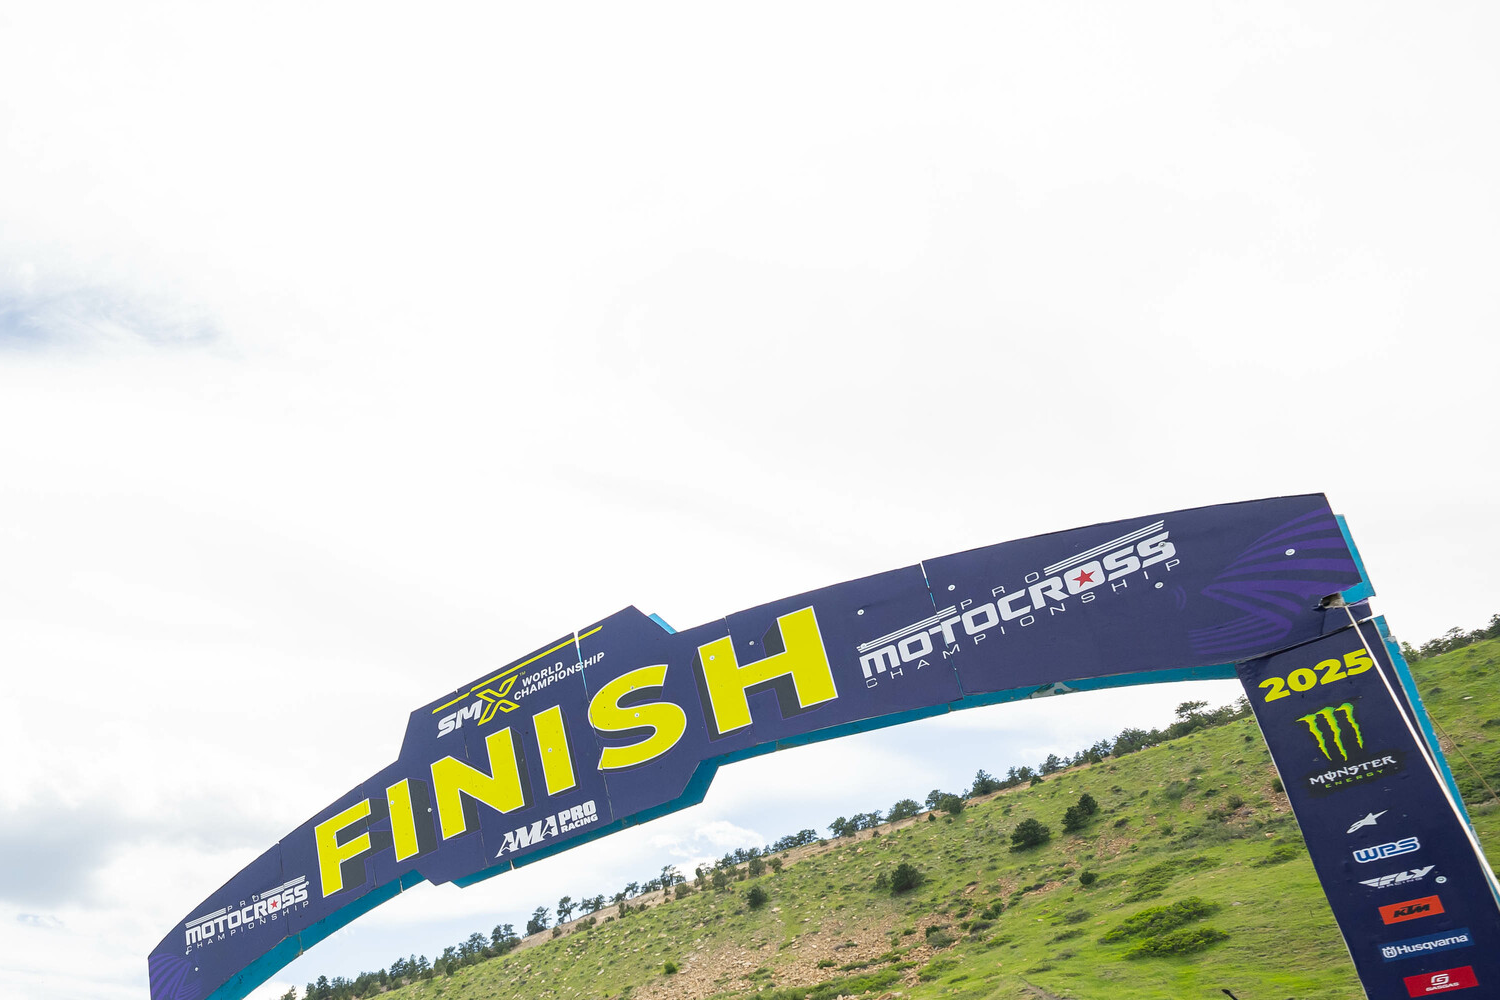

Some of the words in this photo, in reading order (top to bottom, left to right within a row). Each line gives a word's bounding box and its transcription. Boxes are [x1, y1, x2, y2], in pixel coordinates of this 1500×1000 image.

[859, 531, 1177, 679] MOTOCROSS
[960, 571, 1040, 611] PRO
[865, 558, 1181, 689] CHAMPIONSHIP
[513, 651, 605, 701] CHAMPIONSHIP
[522, 661, 563, 687] WORLD
[1258, 648, 1374, 703] 2025
[314, 605, 839, 898] FINISH
[1309, 754, 1397, 785] MONSTER
[1325, 769, 1384, 789] ENERGY
[495, 814, 559, 858] AMA
[559, 800, 596, 825] PRO
[561, 814, 599, 834] RACING
[1353, 836, 1421, 864] WPS
[185, 881, 310, 946] MOTOCROSS
[186, 900, 310, 953] CHAMPIONSHIP
[1393, 903, 1430, 918] KTM
[1396, 933, 1469, 956] Husqvarna
[1425, 981, 1460, 992] GASGAS
